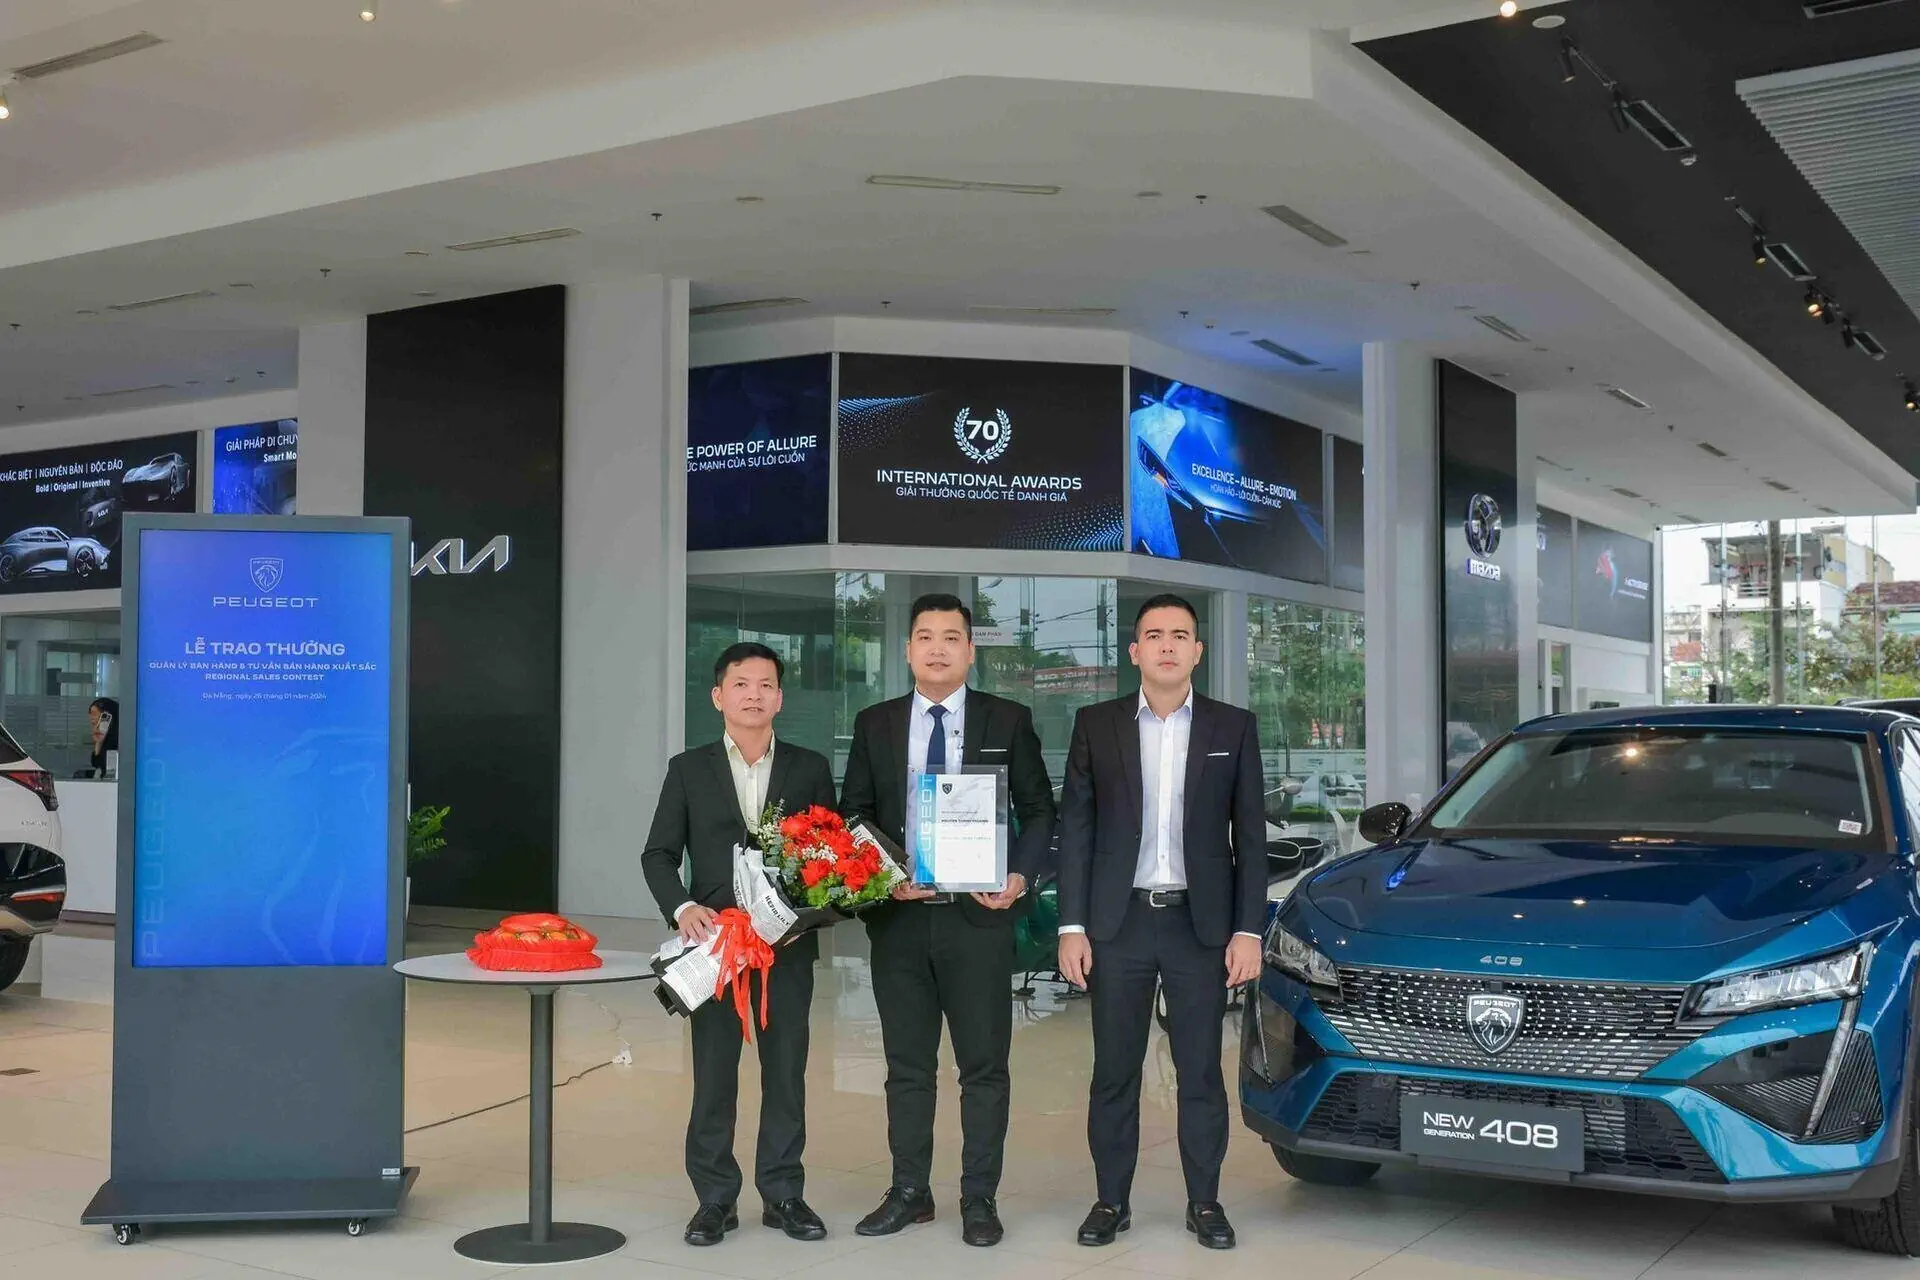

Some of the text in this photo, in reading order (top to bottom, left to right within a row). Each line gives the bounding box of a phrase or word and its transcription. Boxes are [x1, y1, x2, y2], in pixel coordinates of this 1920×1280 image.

[966, 420, 999, 441] 70
[226, 438, 242, 452] GIẢI
[244, 436, 266, 450] PHÁP
[267, 436, 276, 447] DI
[697, 442, 744, 459] POWER
[747, 440, 765, 454] OF
[767, 435, 817, 452] ALLURE
[263, 452, 284, 463] Smart
[700, 459, 726, 472] MẠNH
[727, 456, 747, 469] CỦA
[762, 454, 777, 466] LÔI
[18, 468, 32, 482] BIỆT
[107, 458, 123, 470] ĐÁO
[36, 484, 49, 493] Bold
[53, 481, 78, 493] Original
[82, 478, 110, 489] Inventive
[877, 469, 1082, 490] INTERNATIONAL AWARDS
[1191, 463, 1234, 485] EXCELLENCE
[1240, 476, 1264, 493] ALLURE
[1269, 484, 1297, 501] EMOTION
[896, 485, 917, 497] GIẢI
[919, 486, 965, 499] THƯỞNG
[968, 488, 999, 500] QUỐC
[1017, 491, 1047, 501] DANH
[1049, 491, 1068, 502] GIÁ
[411, 535, 509, 576] KIA
[212, 596, 319, 608] PEUGEOT
[185, 636, 346, 656] LỄ TRAO THƯỞNG
[205, 673, 325, 681] REGIONAL SALES CONTEST
[142, 727, 166, 959] PEUGEOT
[1480, 955, 1523, 966] 408
[1473, 999, 1516, 1008] PEUGEOT
[1423, 1111, 1475, 1130] NEW
[1423, 1128, 1475, 1141] GENERATION
[1480, 1119, 1558, 1149] 408
